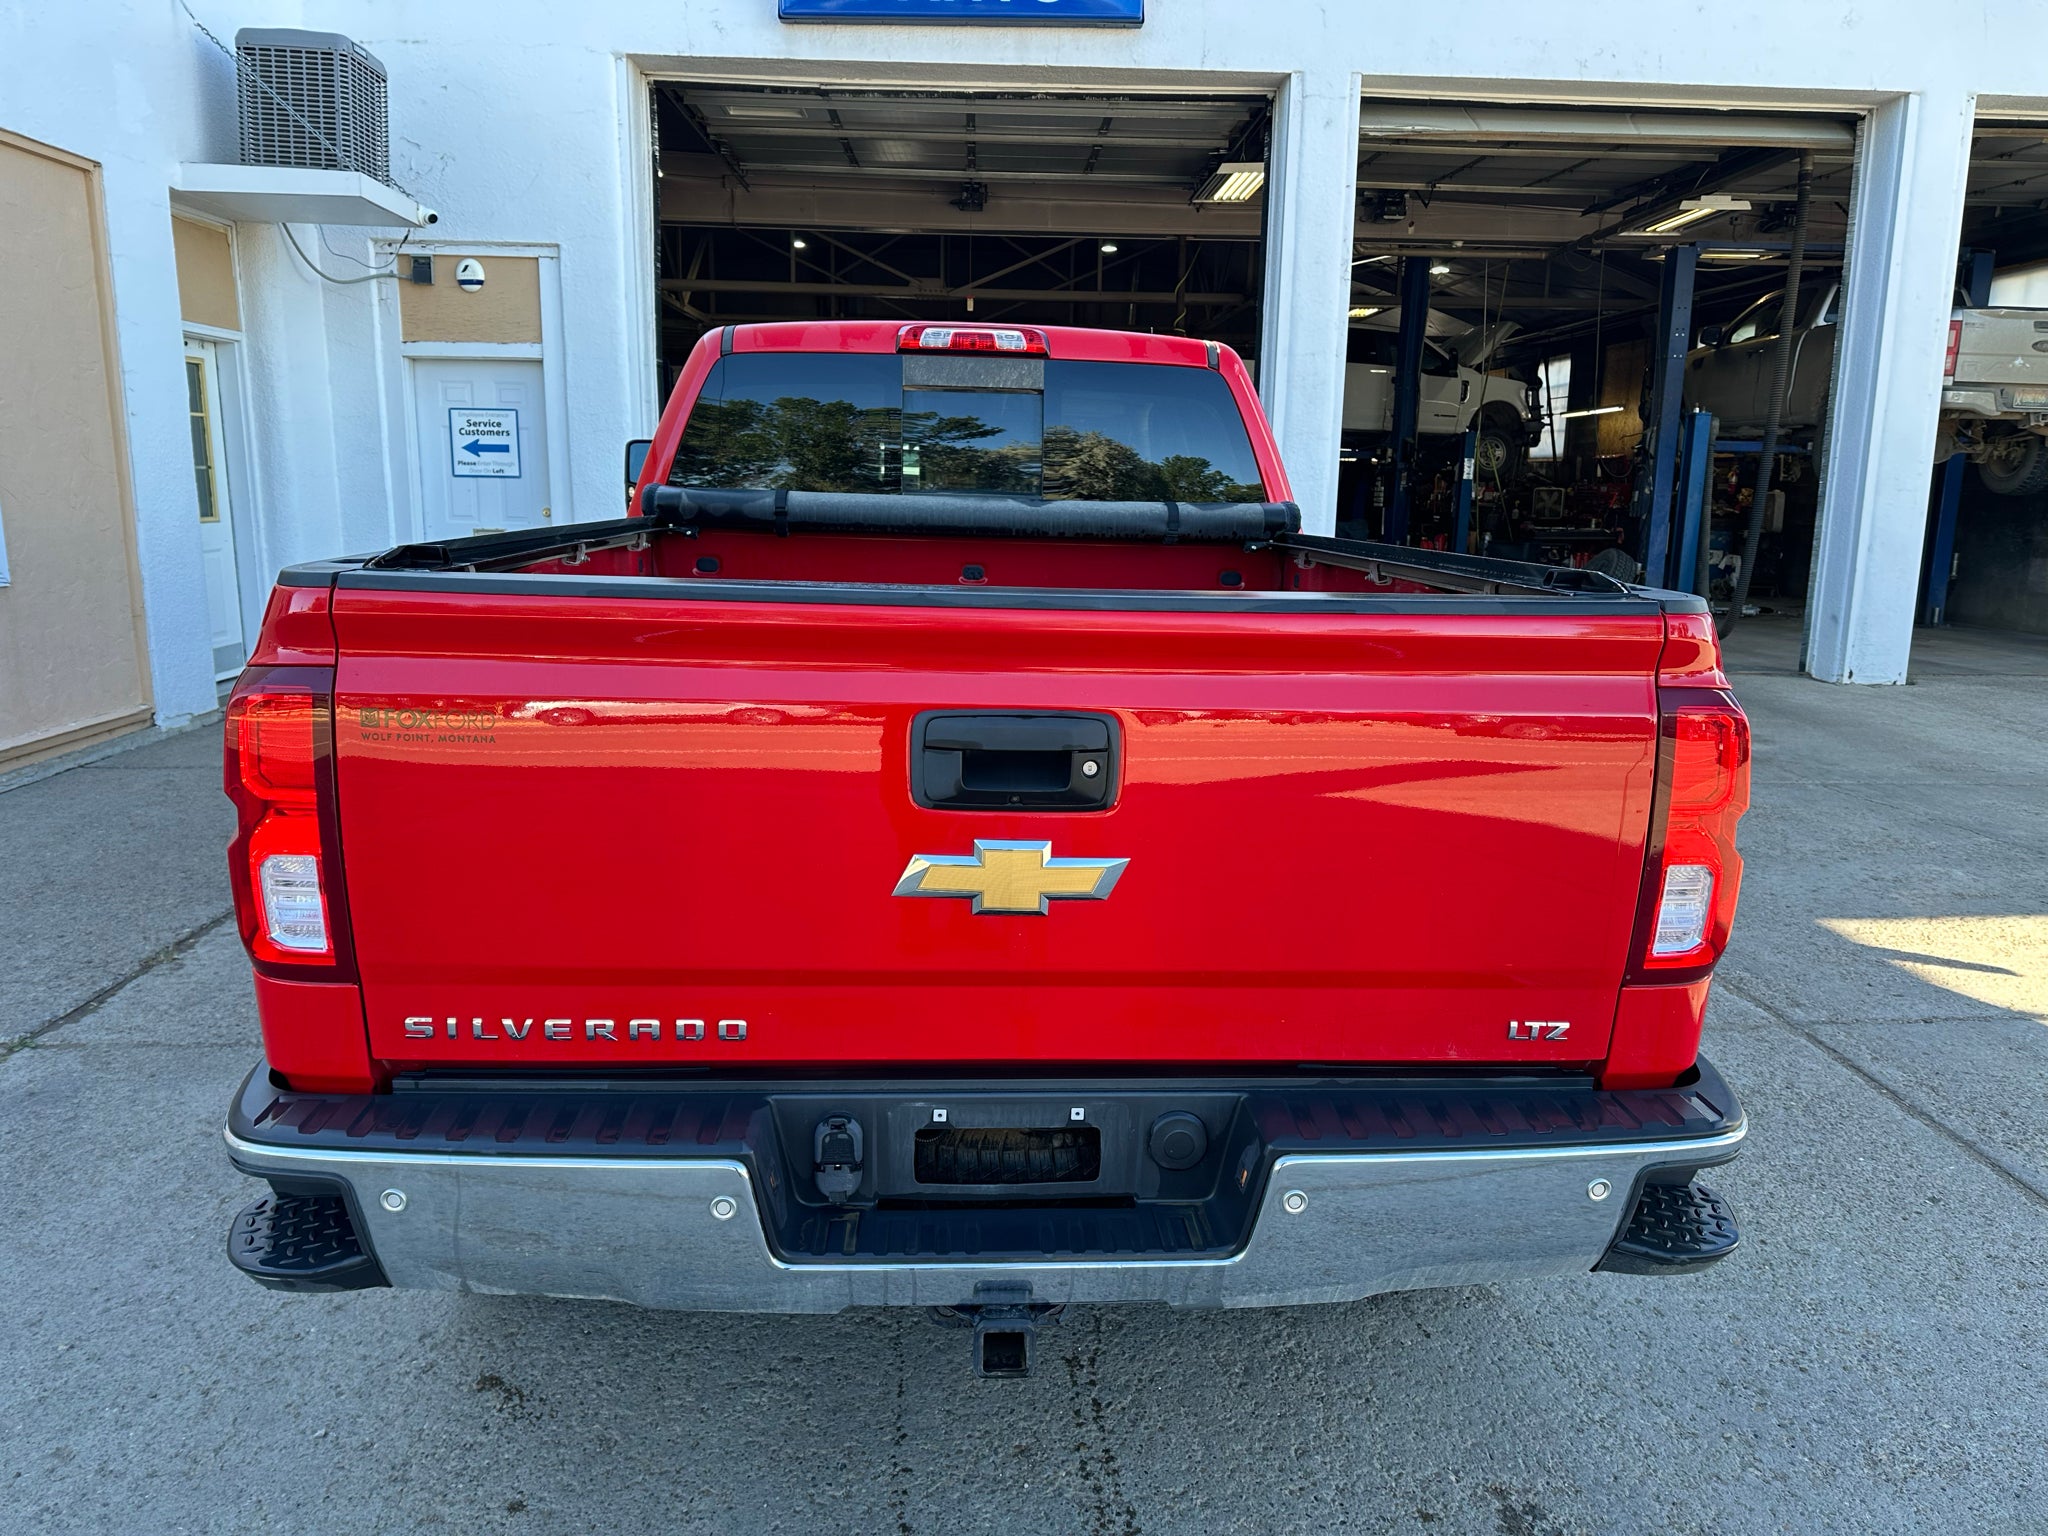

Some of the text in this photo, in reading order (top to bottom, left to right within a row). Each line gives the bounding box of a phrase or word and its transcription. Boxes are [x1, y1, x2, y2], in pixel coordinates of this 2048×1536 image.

[466, 419, 502, 427] Service
[458, 427, 510, 436] Customers
[361, 732, 496, 743] WOLF POINT, MONTANA
[403, 1017, 749, 1041] SILVERADO
[1508, 1020, 1571, 1041] LTZ
